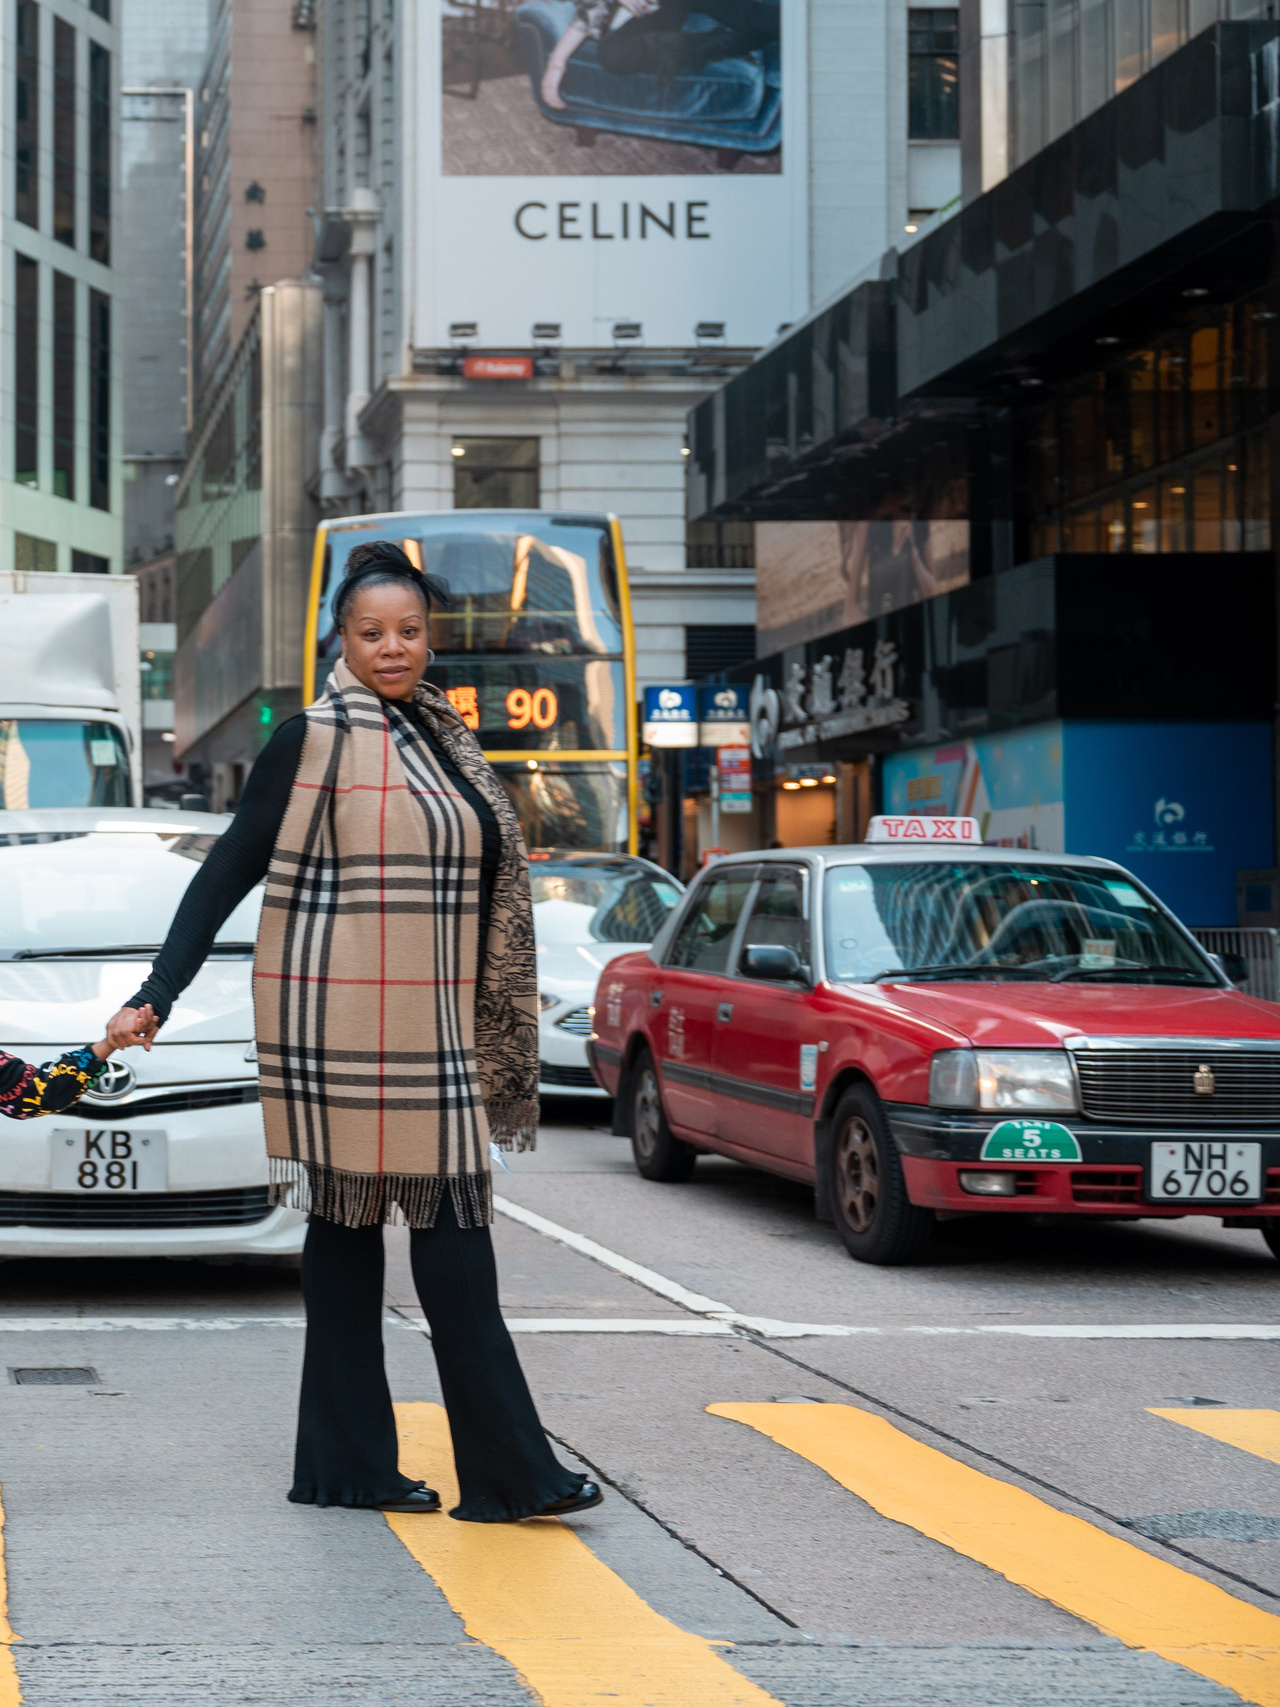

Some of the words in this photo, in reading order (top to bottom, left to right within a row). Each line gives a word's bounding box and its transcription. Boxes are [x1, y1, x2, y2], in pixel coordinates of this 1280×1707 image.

[514, 200, 712, 240] CELINE
[505, 687, 558, 730] 90
[882, 819, 973, 839] TAXI
[84, 1129, 133, 1160] KB
[1022, 1128, 1042, 1148] 5
[1001, 1148, 1062, 1159] SEATS
[1183, 1143, 1228, 1170] NH
[77, 1160, 138, 1190] 881
[1161, 1169, 1250, 1197] 6706
